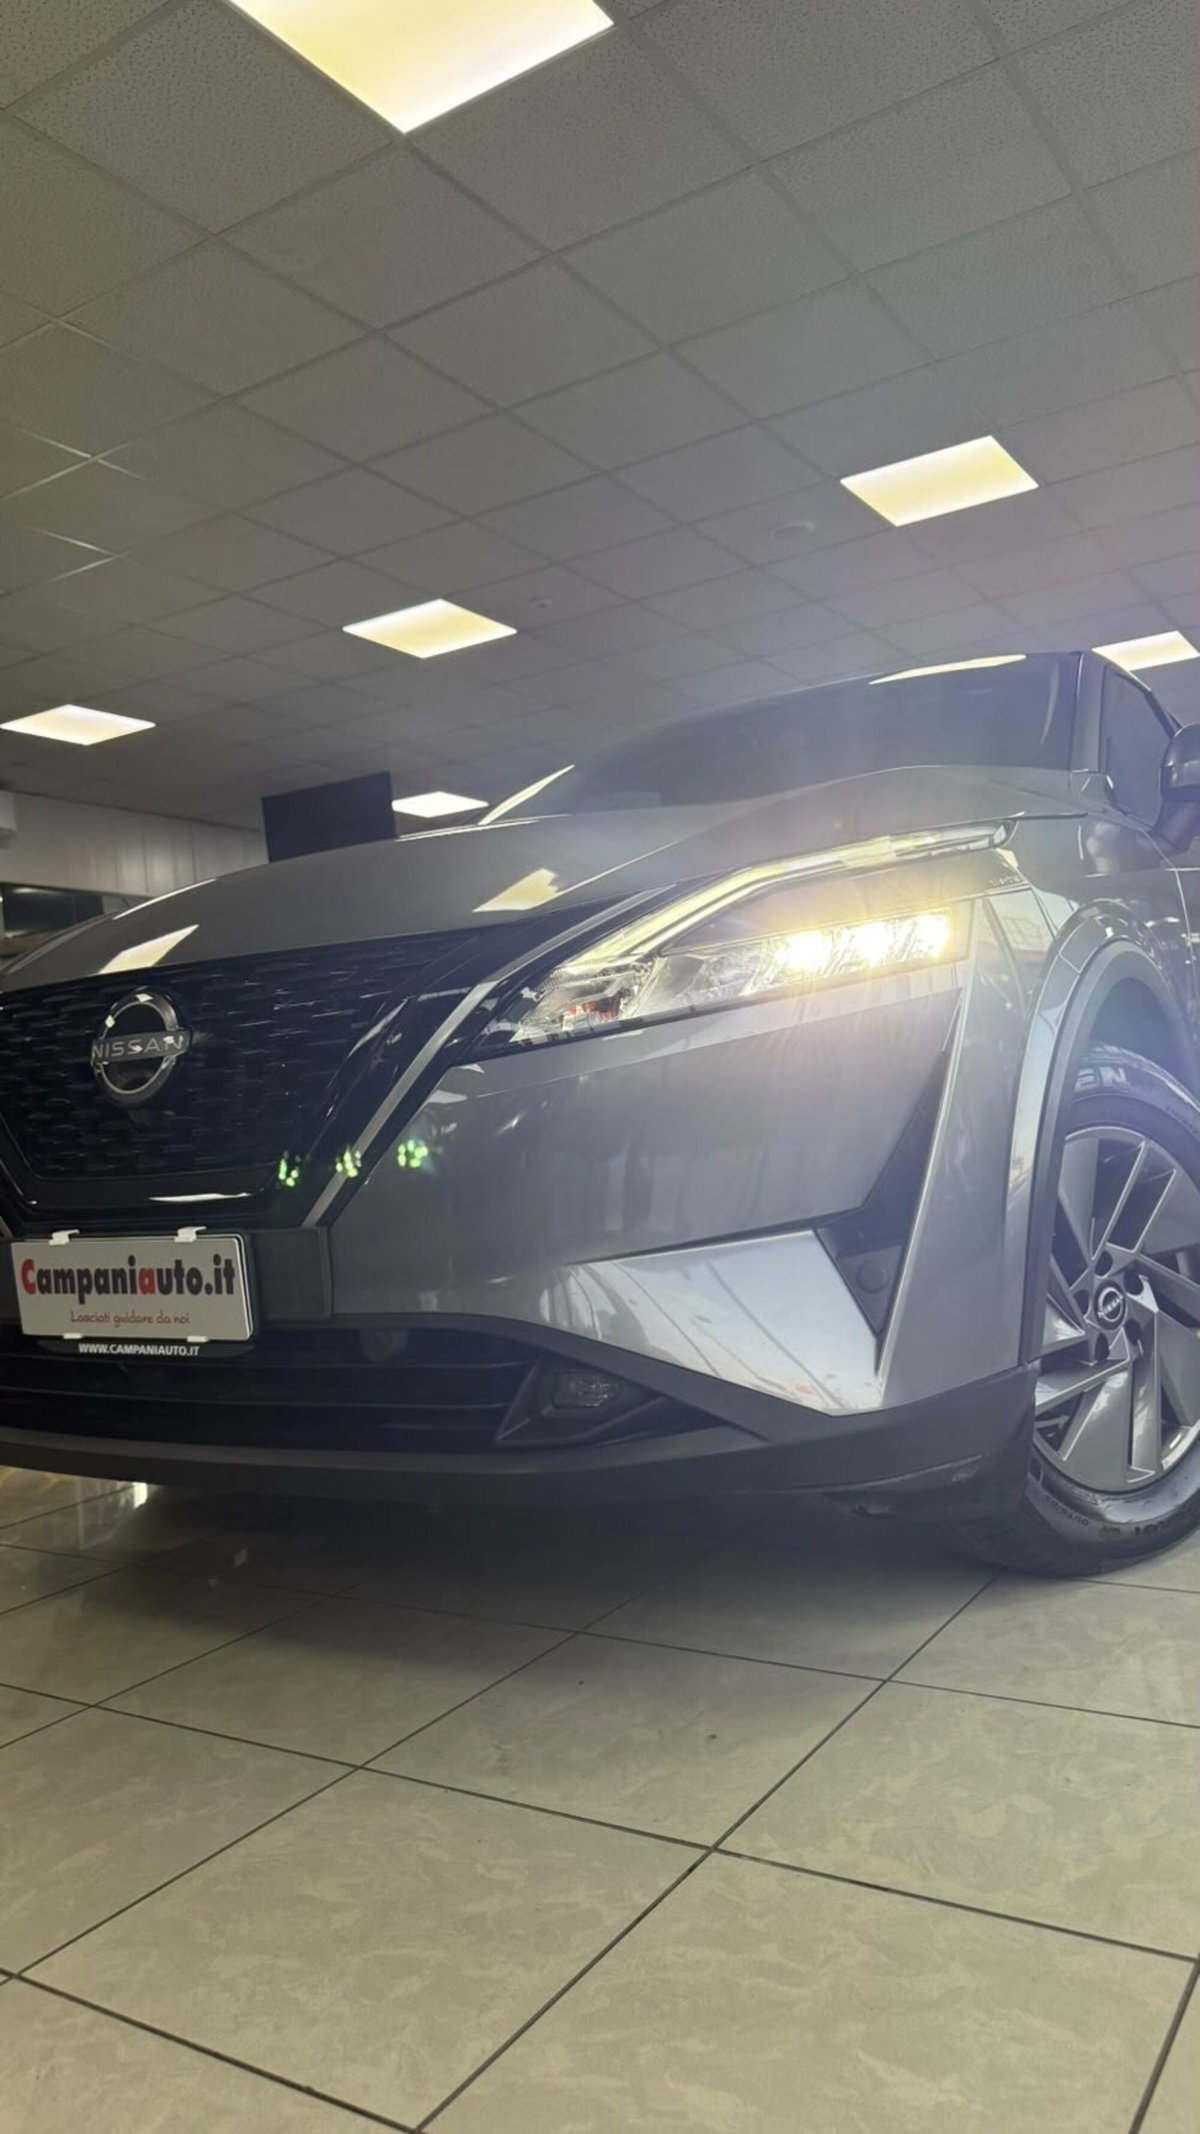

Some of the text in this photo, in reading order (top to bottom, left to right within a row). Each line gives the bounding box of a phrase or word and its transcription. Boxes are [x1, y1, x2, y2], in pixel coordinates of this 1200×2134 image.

[91, 1034, 184, 1060] NISSAN
[21, 1253, 236, 1305] Campaniauto.it
[70, 1308, 190, 1328] Lasciati guidare da noi
[78, 1343, 200, 1356] WWW.CAMPANIAUTO.IT
